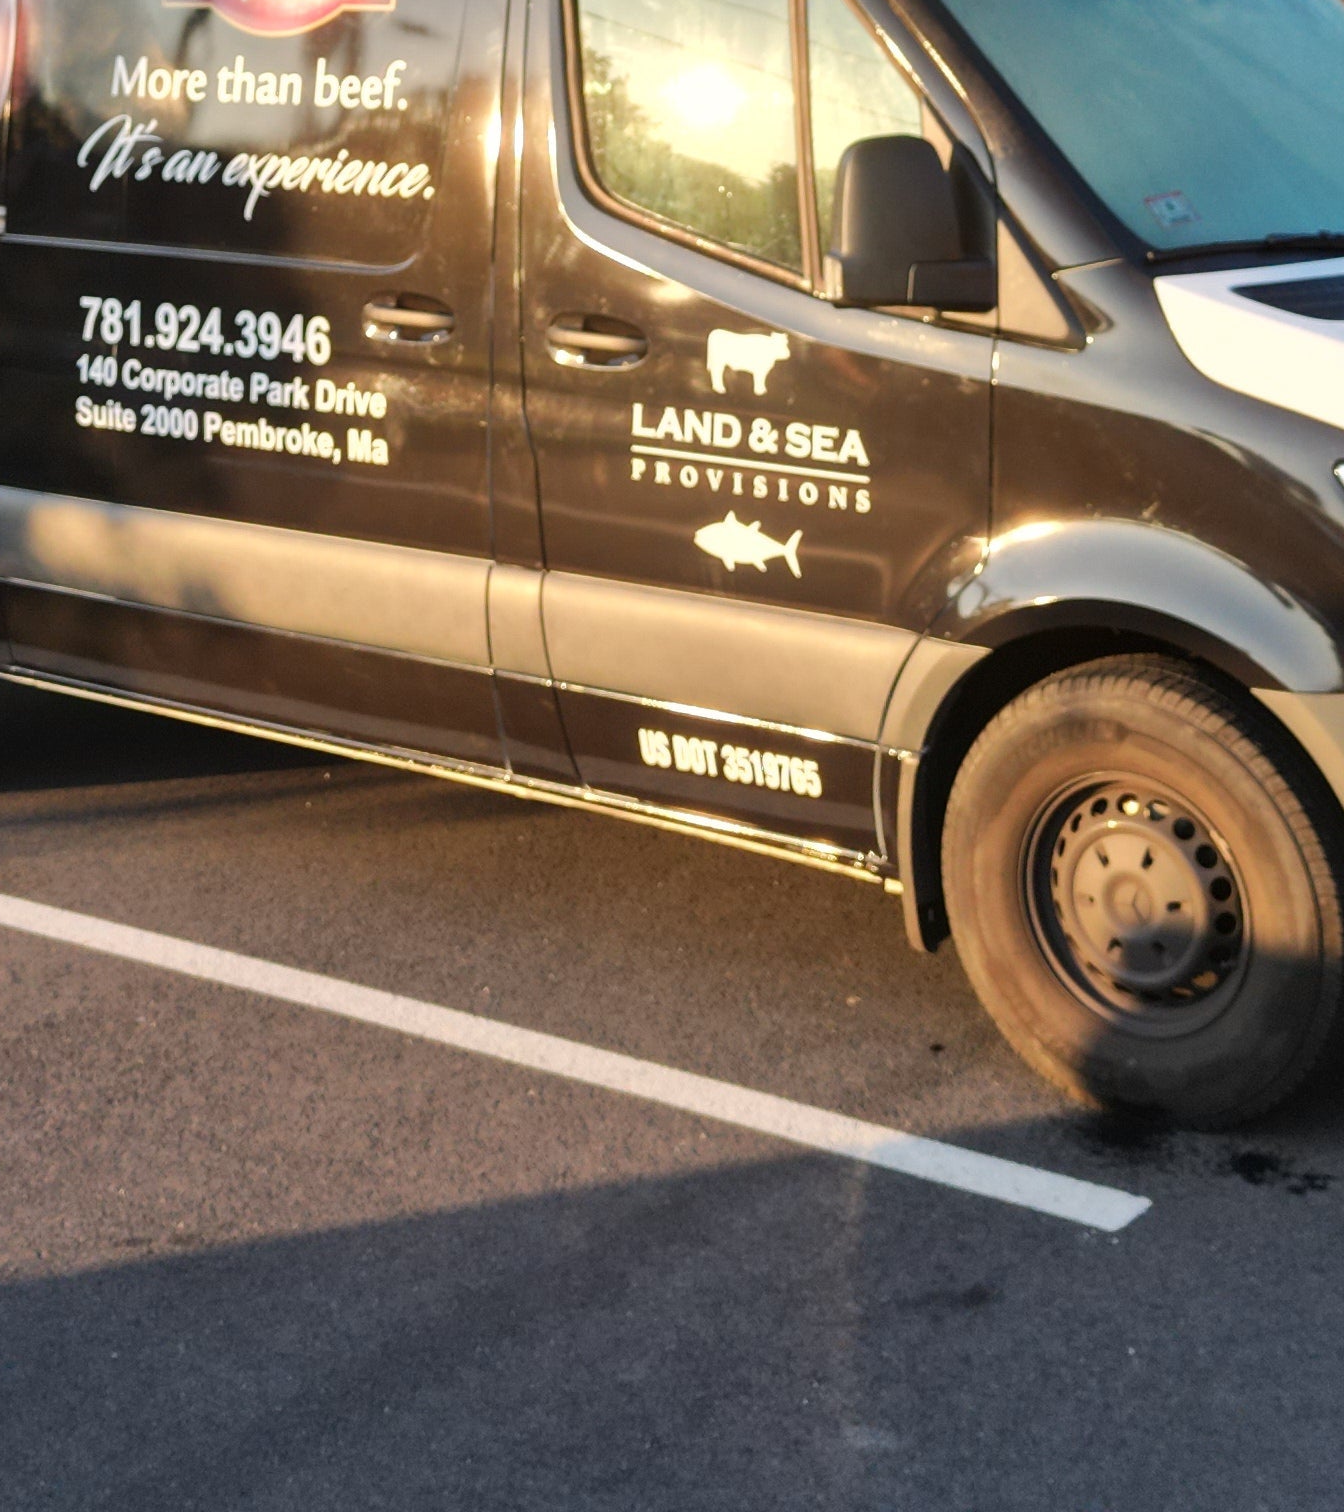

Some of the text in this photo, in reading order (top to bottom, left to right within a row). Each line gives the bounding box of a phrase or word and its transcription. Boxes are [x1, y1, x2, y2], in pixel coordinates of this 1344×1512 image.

[110, 54, 409, 112] More than beef.
[76, 113, 436, 222] It's an experience.
[78, 294, 332, 367] 781.924.3946
[76, 353, 388, 420] 140 Corporate Park Drive
[75, 395, 390, 467] Suite 2000 Pembroke, Ma
[630, 402, 871, 468] LAND & SEA
[630, 457, 872, 514] PROVISIONS
[637, 727, 823, 799] US DOT 3519765
